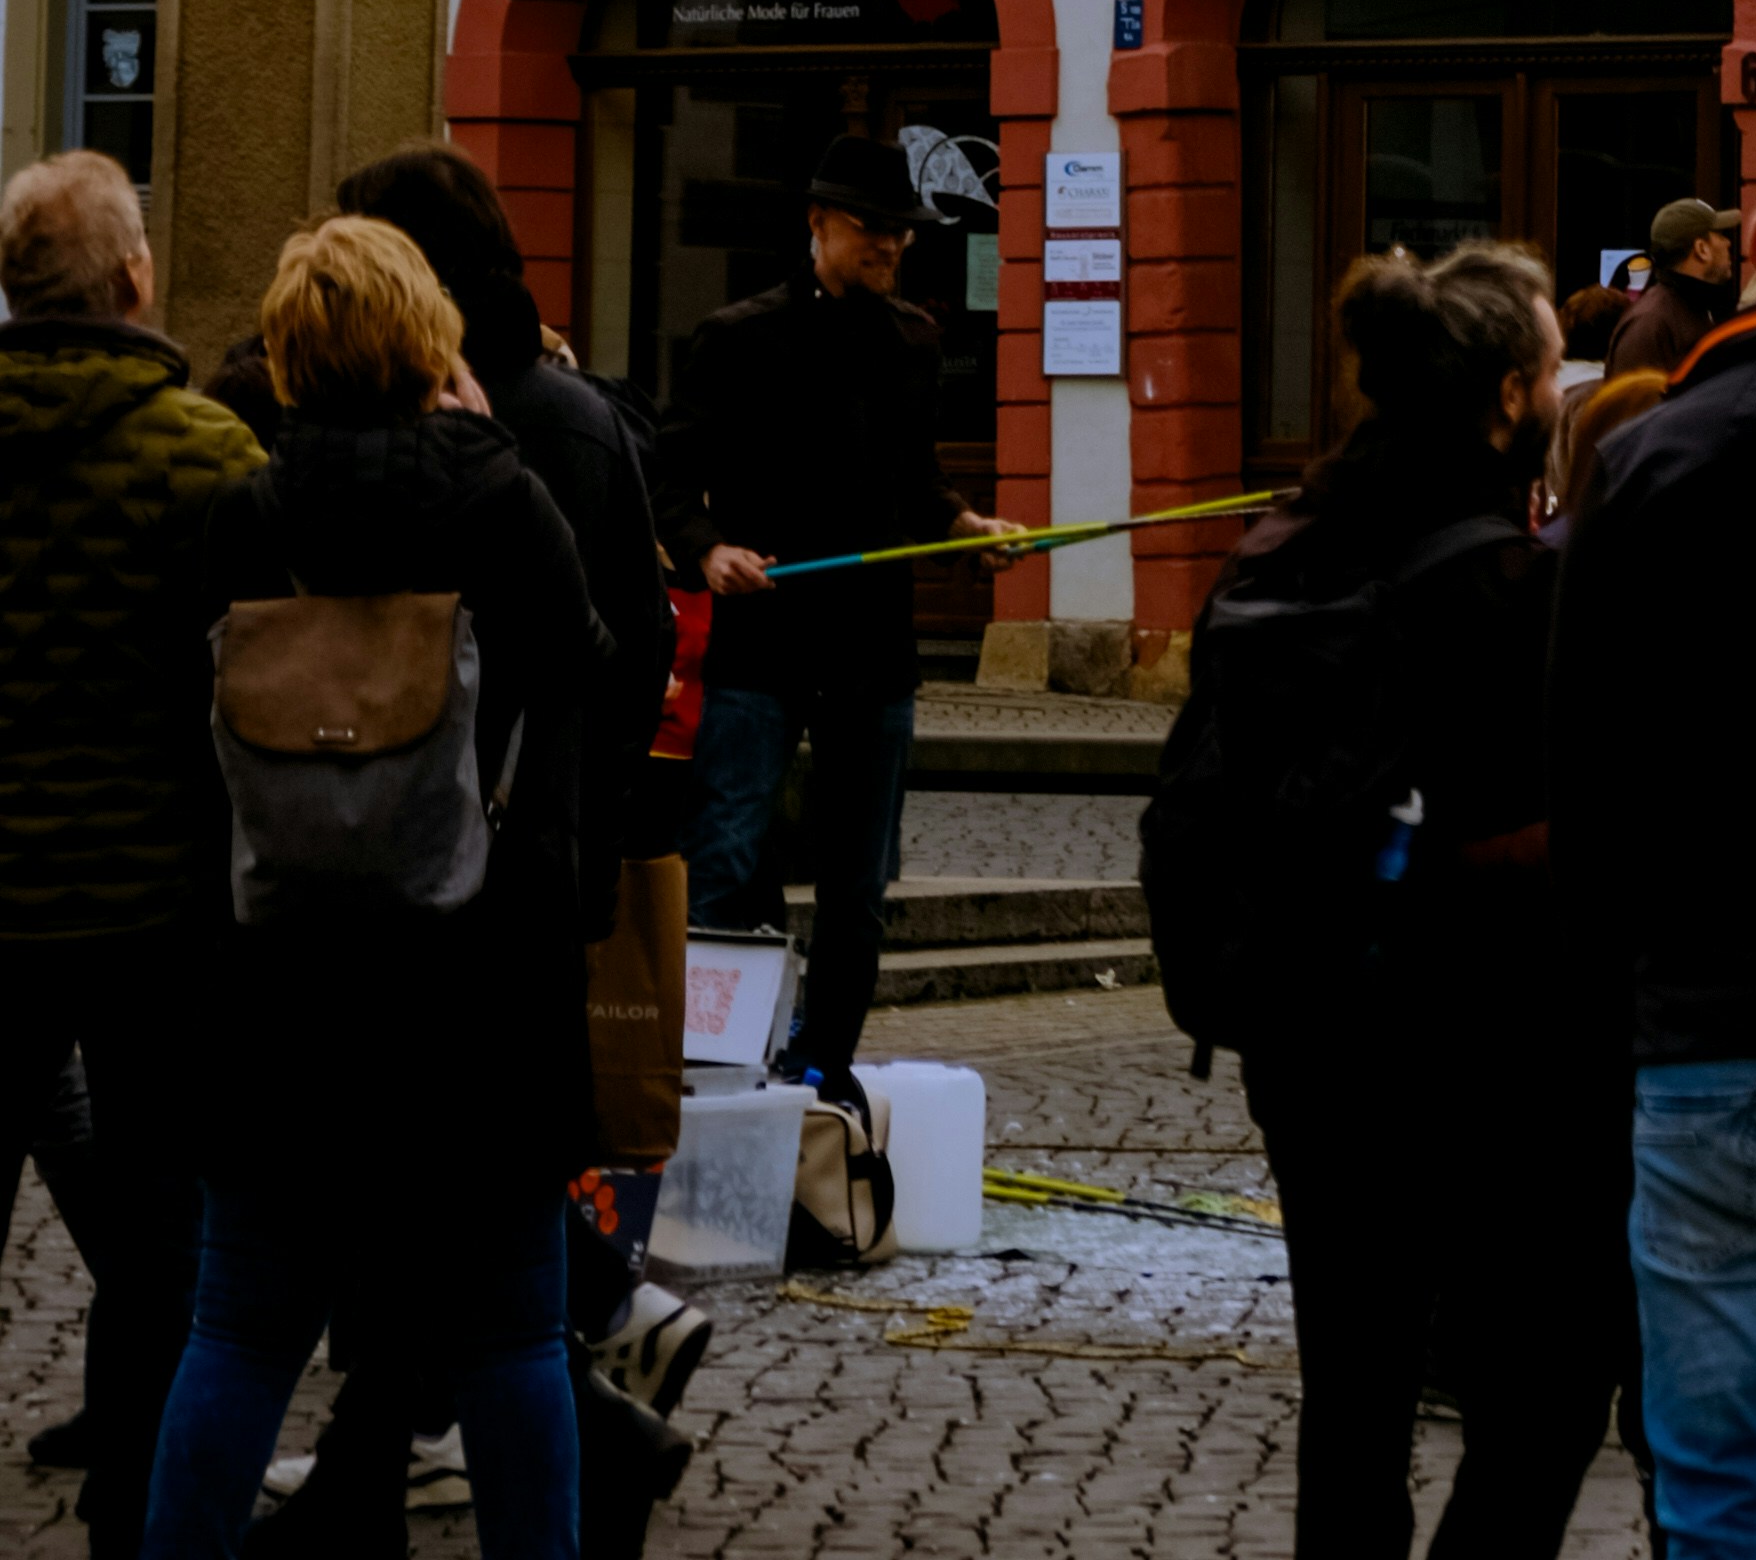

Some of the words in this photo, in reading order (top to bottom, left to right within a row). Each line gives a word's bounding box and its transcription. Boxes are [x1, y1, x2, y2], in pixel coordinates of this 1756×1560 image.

[673, 4, 744, 23] Natürliche
[747, 2, 787, 21] Mode
[791, 2, 810, 20] für
[813, 2, 860, 19] Frauen
